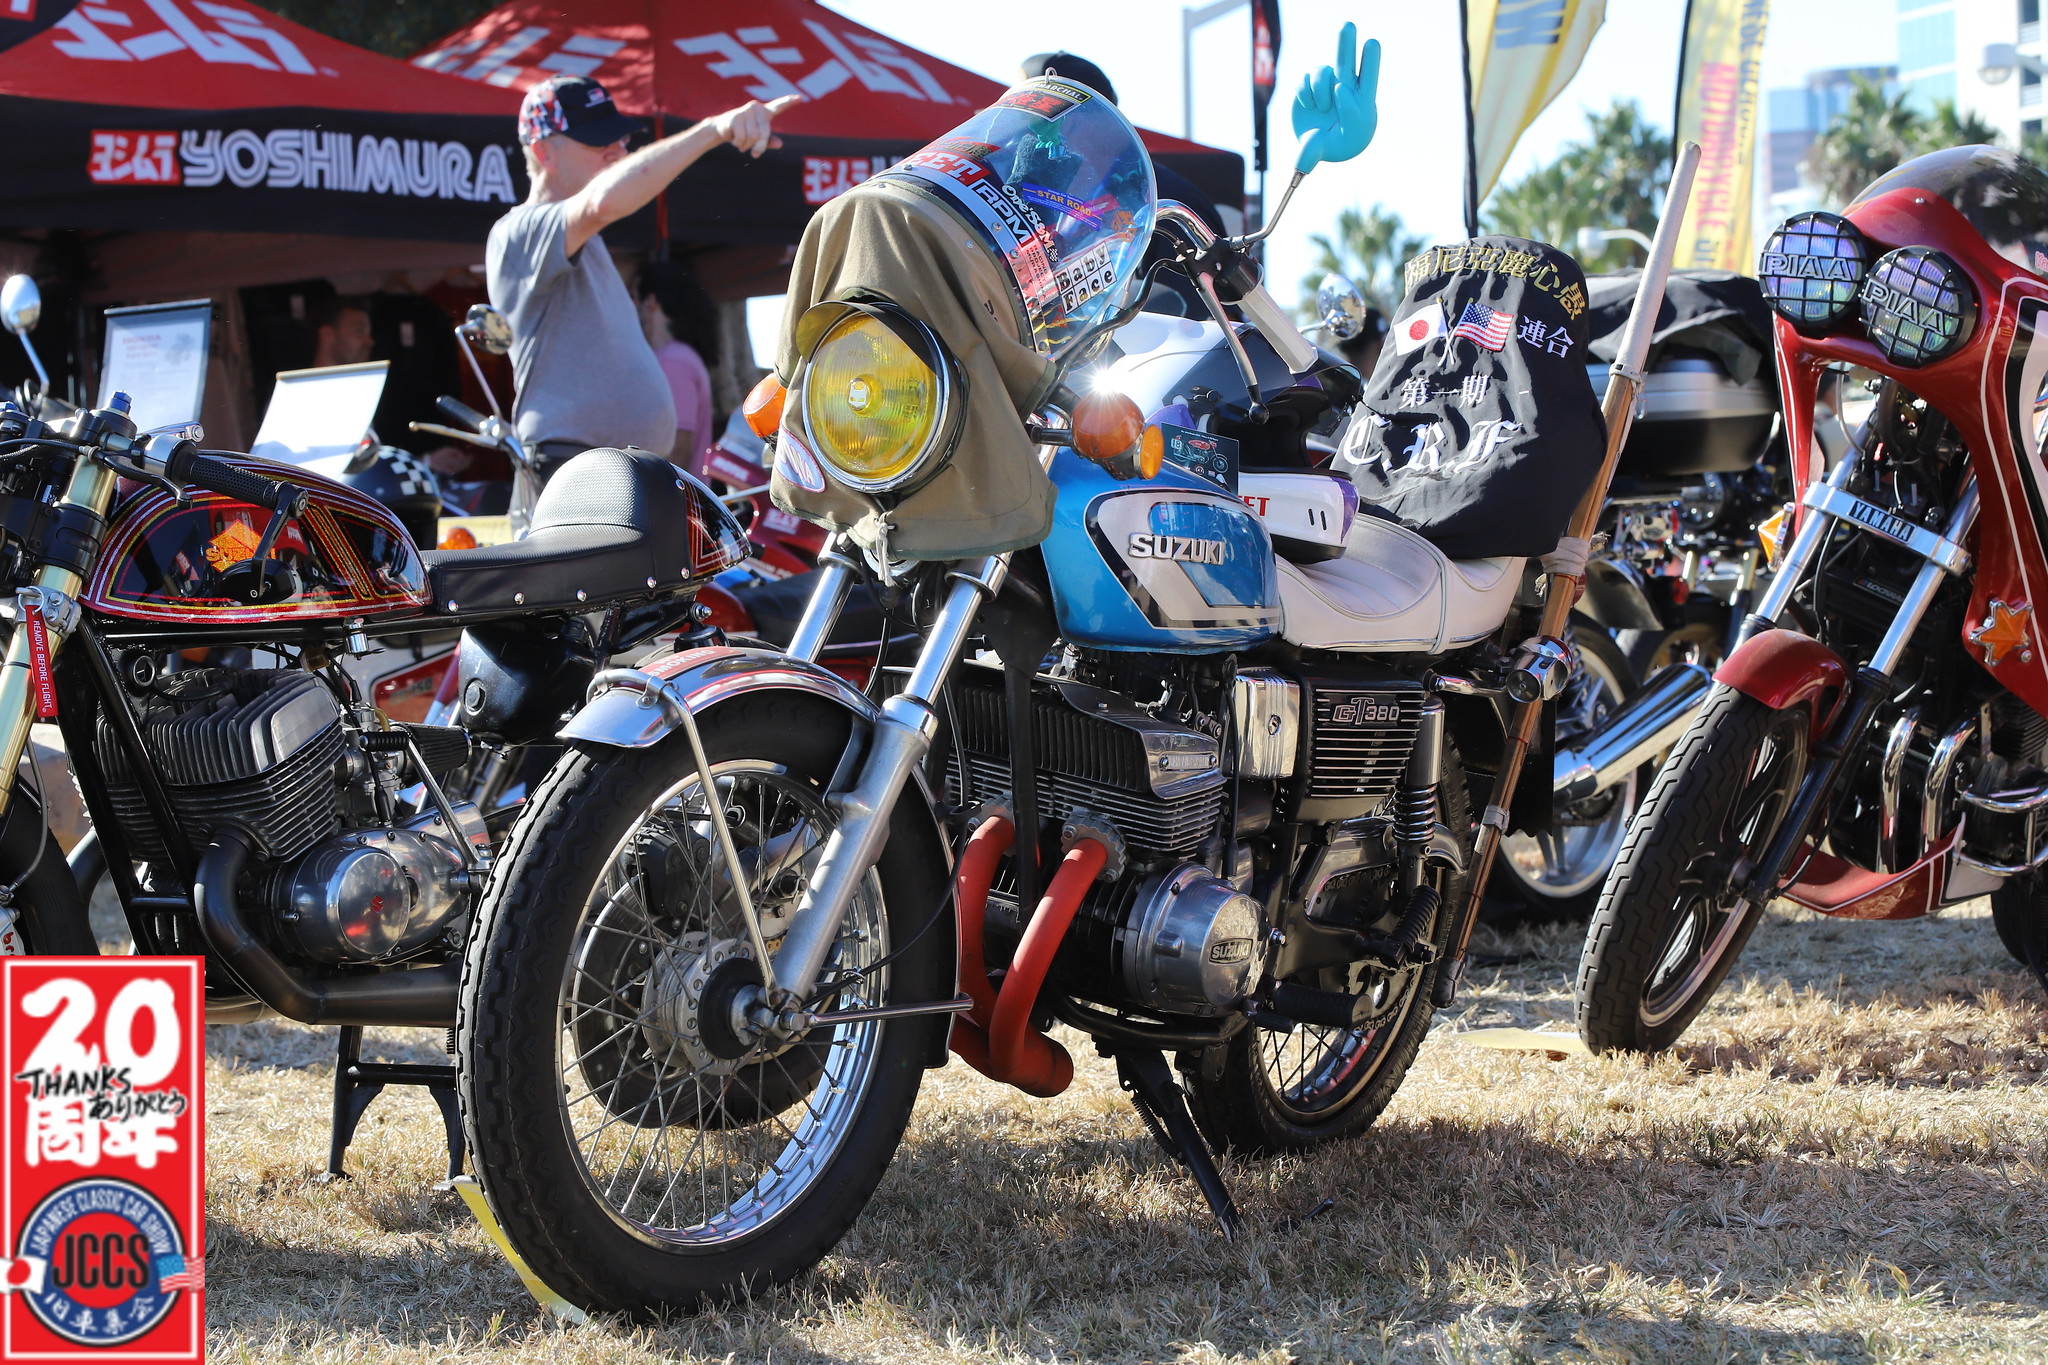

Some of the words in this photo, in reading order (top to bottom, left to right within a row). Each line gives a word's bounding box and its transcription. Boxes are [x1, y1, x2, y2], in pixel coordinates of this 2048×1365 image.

[180, 128, 517, 203] YOSHIMURA
[976, 183, 1031, 246] RPM
[1036, 190, 1064, 204] STAR
[1066, 199, 1092, 217] ROAD
[1056, 245, 1107, 290] Baby
[1758, 252, 1854, 281] PIAA
[1061, 269, 1113, 312] Face
[1863, 278, 1946, 337] PIAA
[1517, 315, 1574, 359] 連合
[1399, 374, 1489, 410] 第一期
[1853, 501, 1913, 542] YAMAHA
[1128, 532, 1226, 566] SUZUKI
[32, 620, 44, 652] REMOVE
[36, 653, 48, 682] BEFORE
[40, 682, 53, 709] FLIGHT
[1332, 696, 1400, 725] GT380
[1211, 941, 1250, 960] SUZUKI
